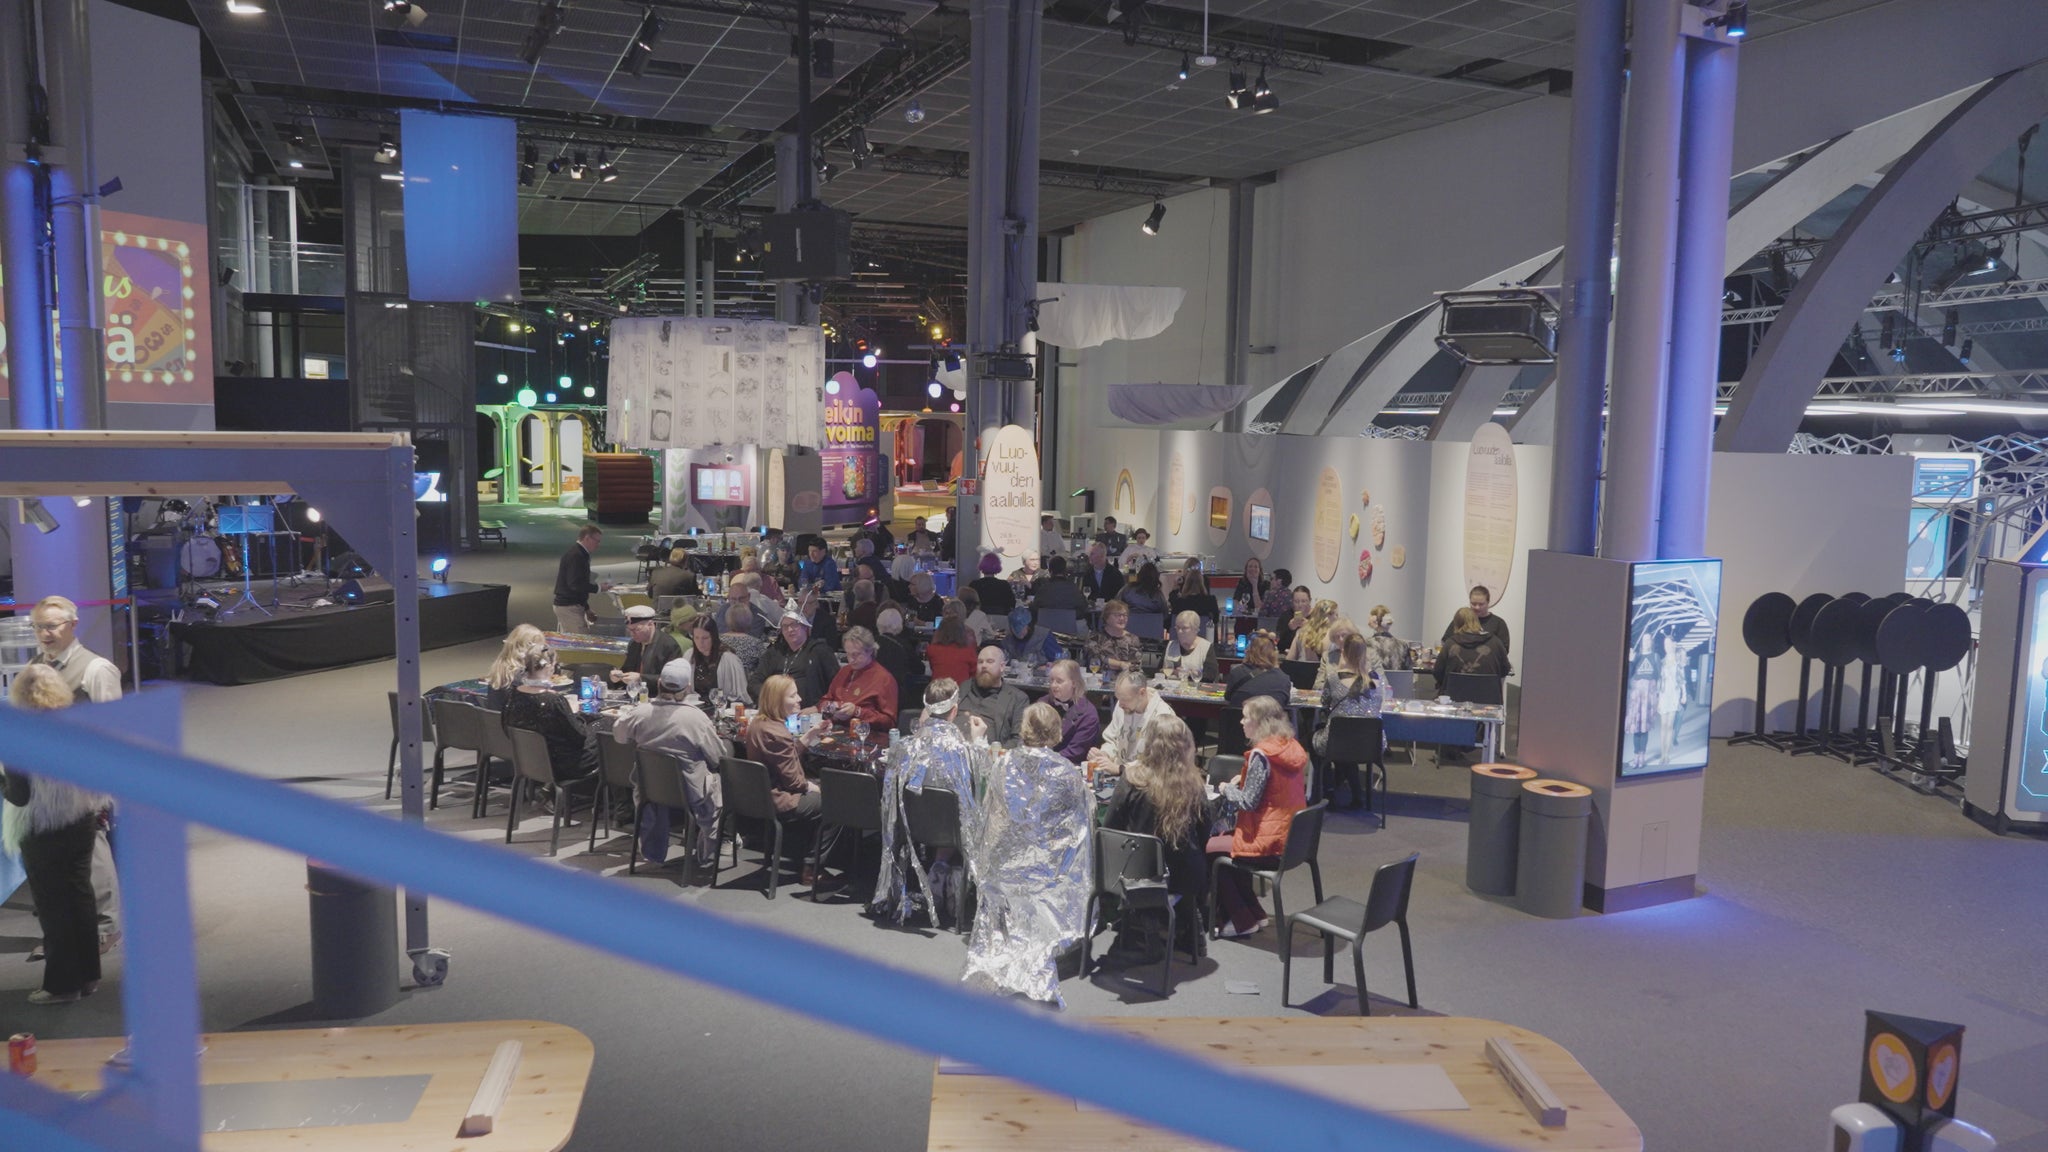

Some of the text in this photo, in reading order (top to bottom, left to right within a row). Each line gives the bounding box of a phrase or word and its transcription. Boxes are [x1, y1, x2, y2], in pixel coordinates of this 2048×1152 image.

[106, 313, 136, 363] ä
[825, 398, 863, 425] eikin
[825, 421, 875, 442] voima
[999, 443, 1028, 459] Luo-
[992, 461, 1019, 473] vuu-
[1010, 471, 1034, 488] den
[989, 491, 1035, 508] aalloilla
